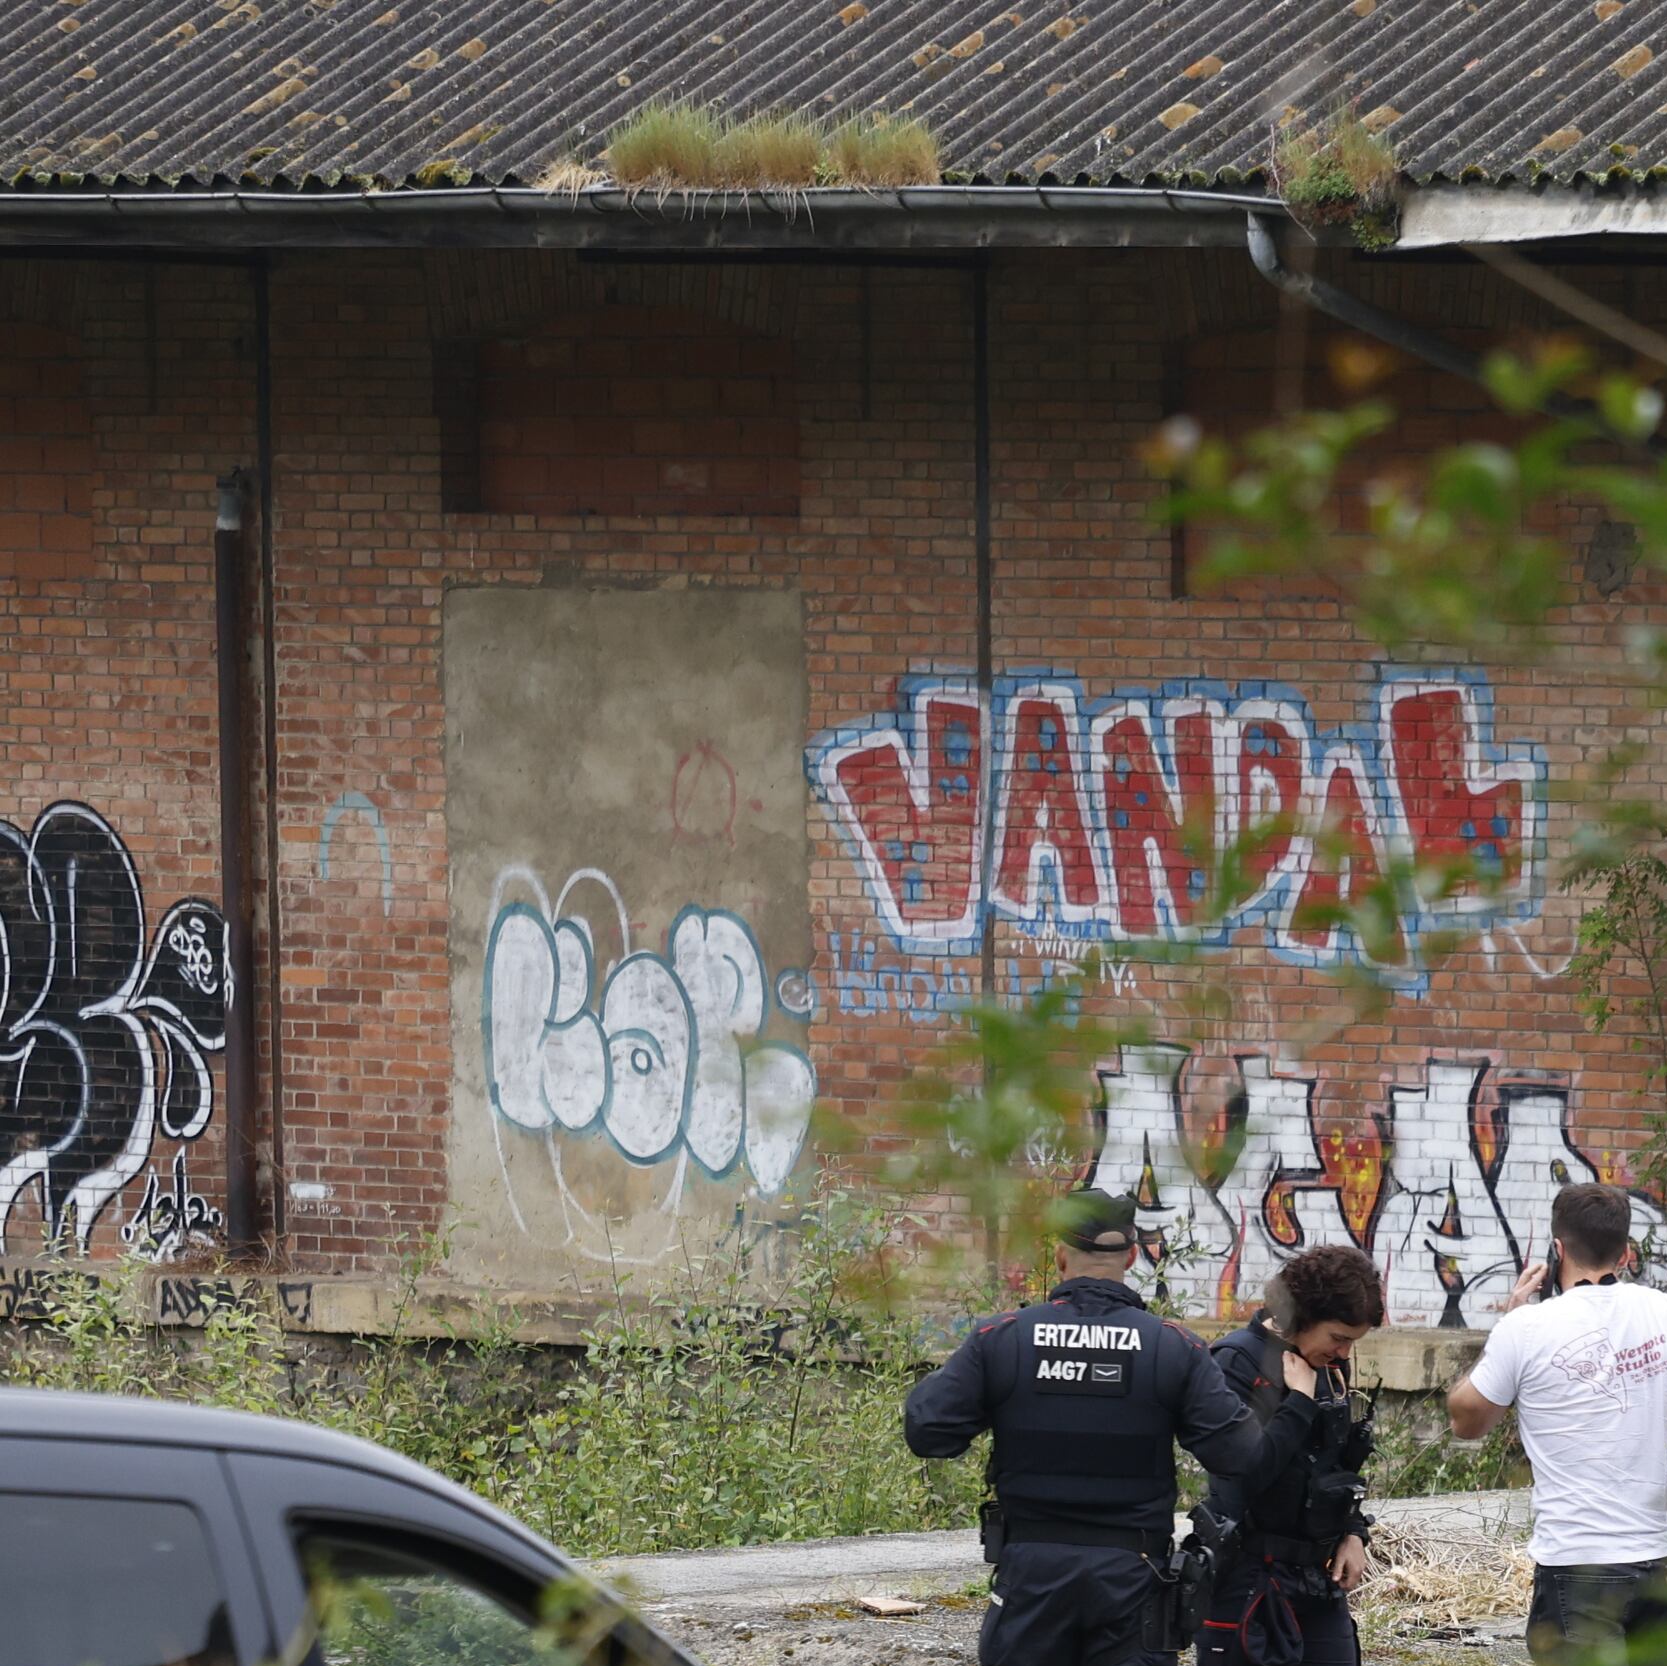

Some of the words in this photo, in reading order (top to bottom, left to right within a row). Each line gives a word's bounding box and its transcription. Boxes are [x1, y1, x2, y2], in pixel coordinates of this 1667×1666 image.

[806, 664, 1548, 998] VANDAL
[1033, 1323, 1142, 1350] ERTZAINTZA
[1036, 1360, 1087, 1381] A4G7
[1615, 1350, 1661, 1376] Studio
